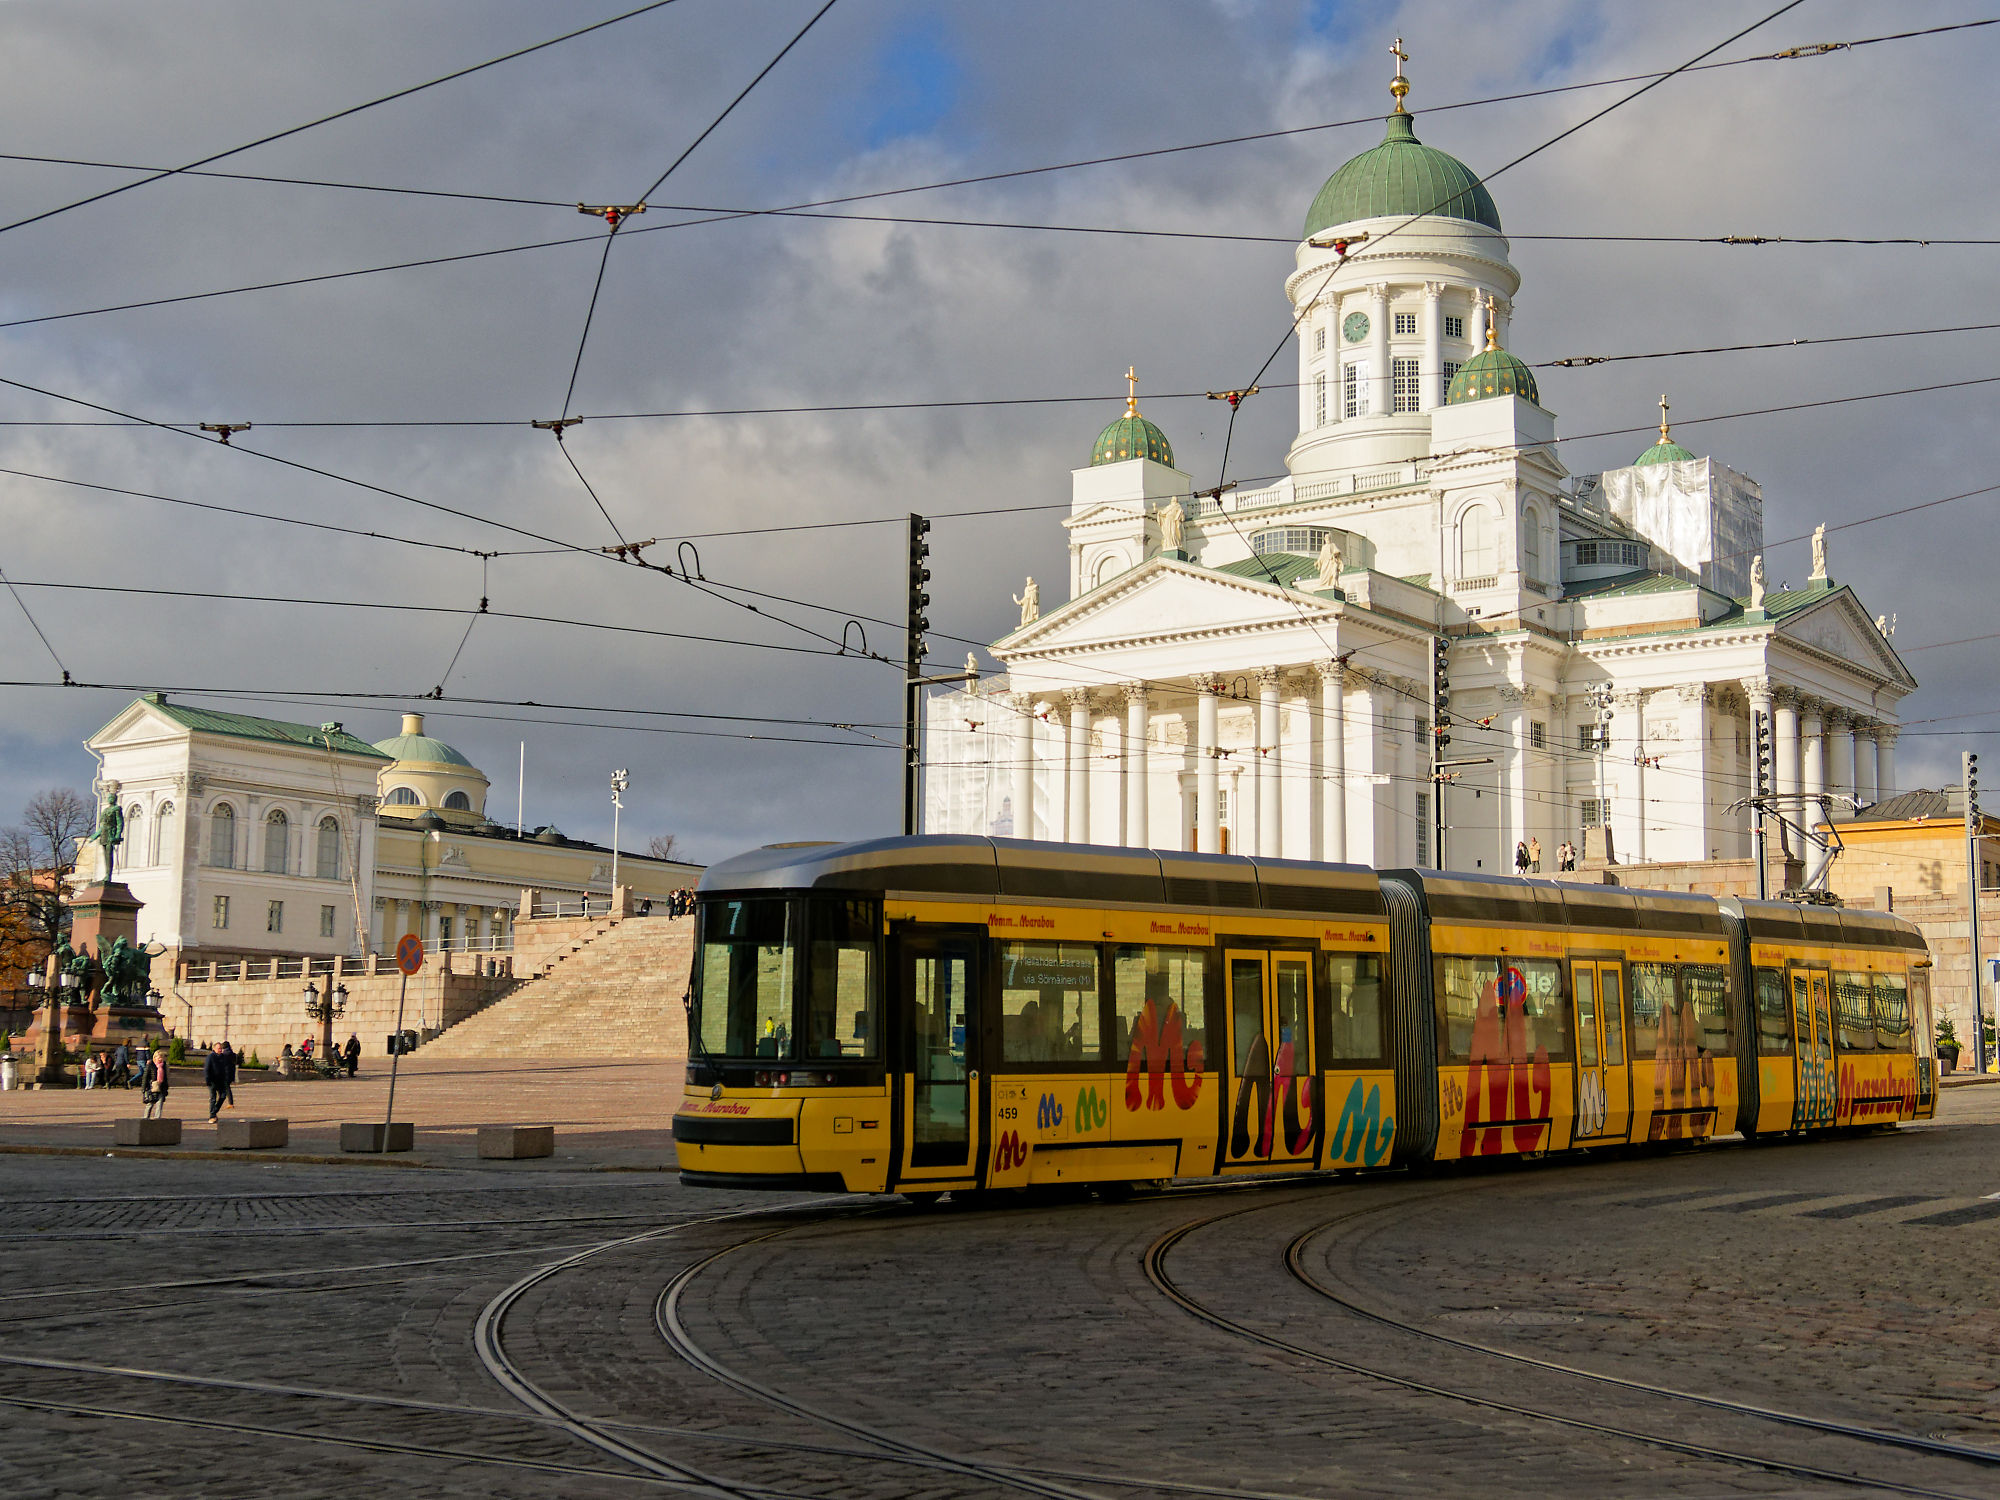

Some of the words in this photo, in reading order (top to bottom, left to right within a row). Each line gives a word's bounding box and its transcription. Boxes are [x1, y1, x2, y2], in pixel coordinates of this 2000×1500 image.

[728, 902, 742, 935] 7
[1020, 914, 1055, 928] Marabou
[1178, 921, 1209, 935] Marabou
[1002, 953, 1020, 986] 7
[1023, 973, 1036, 984] via
[1836, 1061, 1915, 1118] Marabou
[702, 1101, 750, 1115] Marabou
[998, 1107, 1018, 1119] 459
